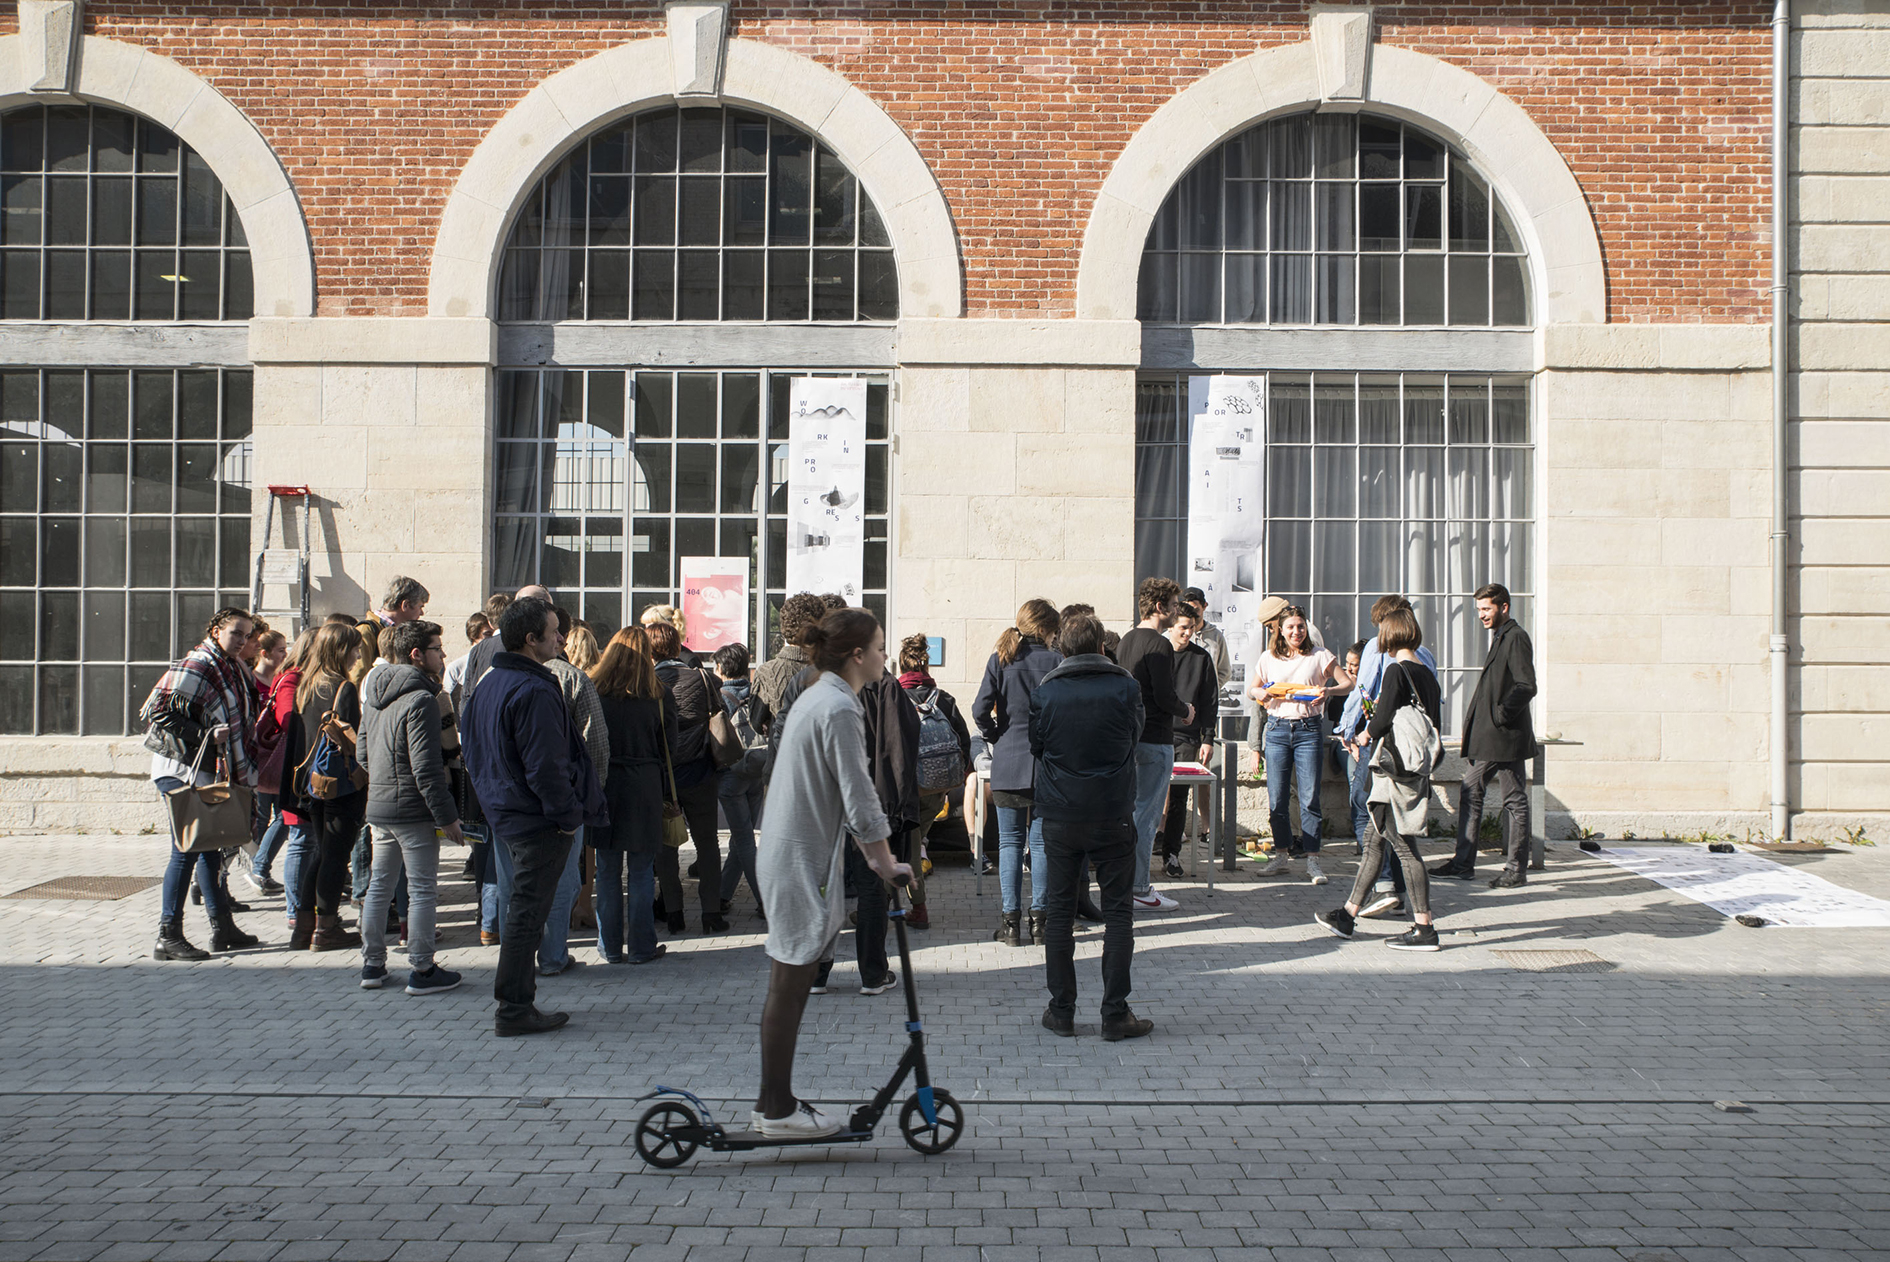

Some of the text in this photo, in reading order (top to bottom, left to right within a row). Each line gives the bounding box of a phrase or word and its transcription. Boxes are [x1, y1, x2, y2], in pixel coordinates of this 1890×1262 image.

[686, 588, 700, 596] 404
[1208, 583, 1213, 592] À
[1227, 604, 1237, 613] CÔ
[1234, 652, 1239, 661] É
